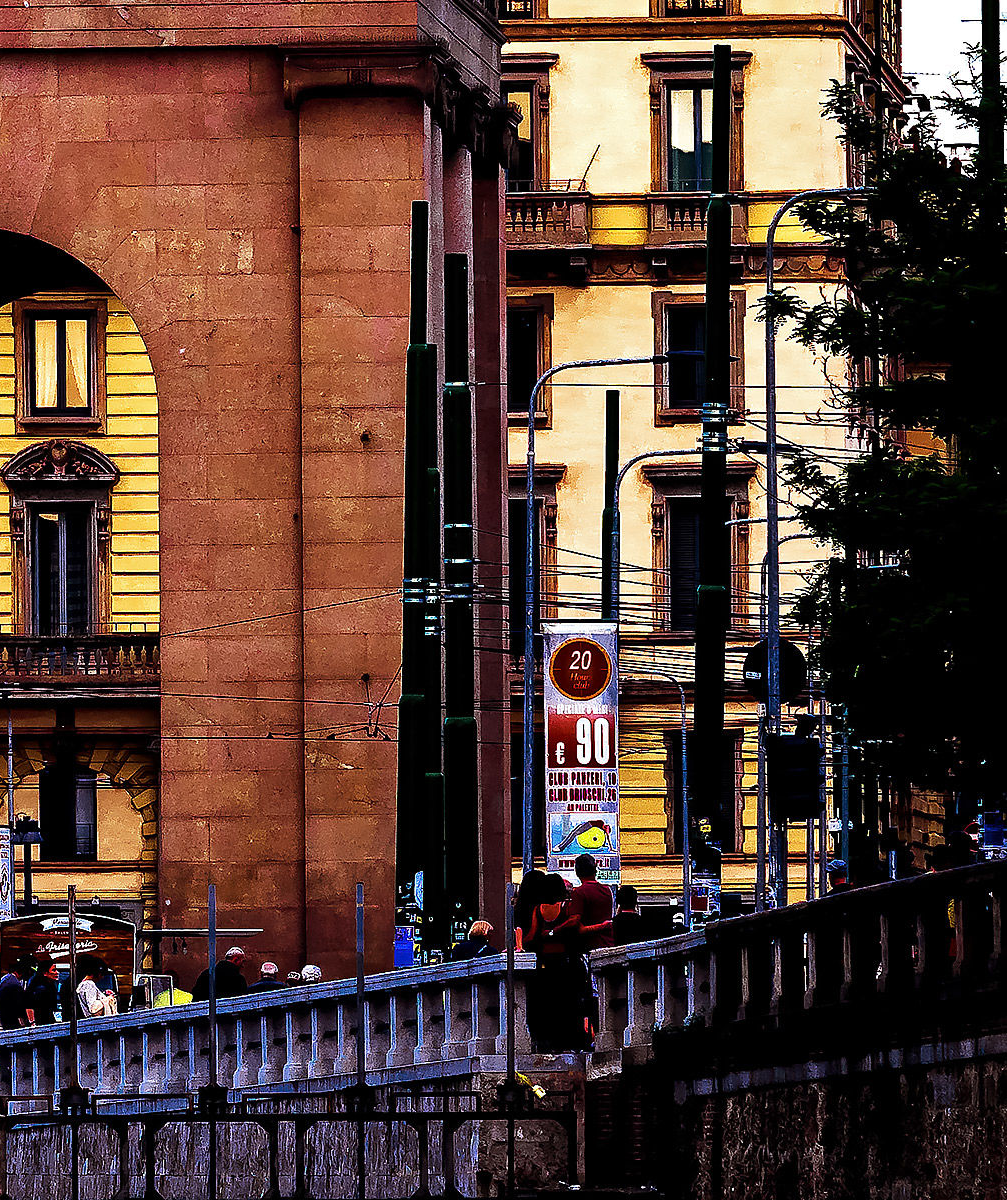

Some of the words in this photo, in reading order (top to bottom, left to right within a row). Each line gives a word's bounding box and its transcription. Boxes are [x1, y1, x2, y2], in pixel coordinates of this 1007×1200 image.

[569, 650, 592, 670] 20
[576, 717, 610, 765] 90
[548, 772, 568, 786] CLUB
[548, 788, 568, 802] CLUB
